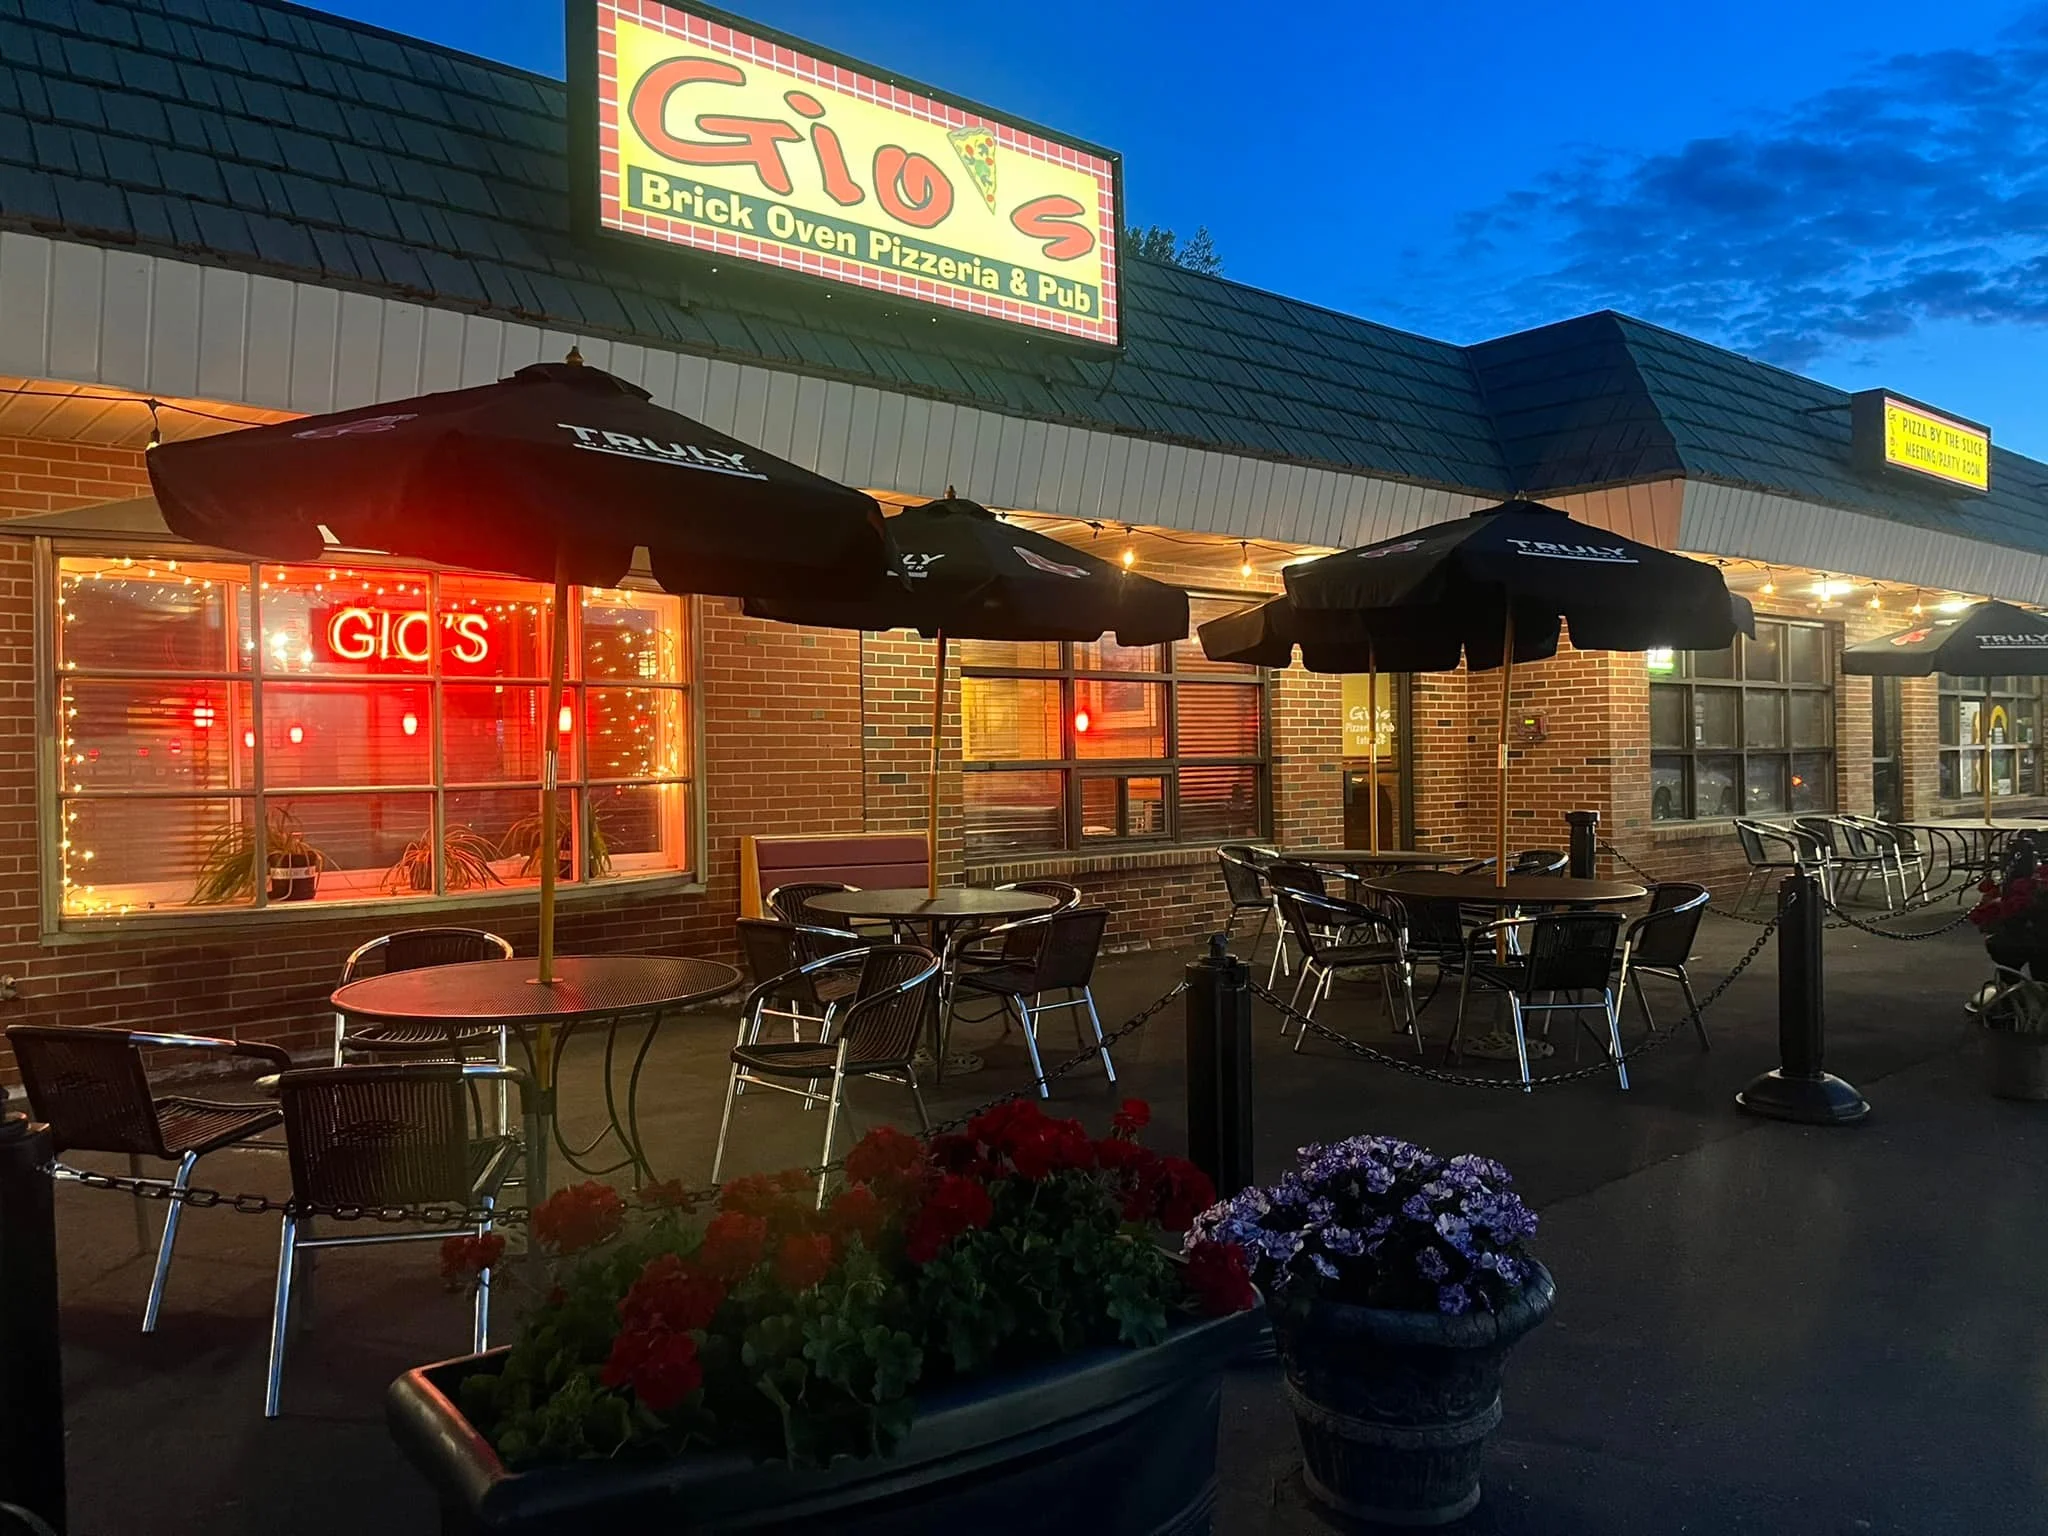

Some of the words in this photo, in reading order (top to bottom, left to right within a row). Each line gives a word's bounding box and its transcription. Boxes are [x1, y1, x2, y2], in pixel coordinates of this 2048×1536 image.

[641, 172, 754, 230] Brick
[766, 204, 857, 255] Oven
[868, 230, 999, 291] Pizzeria
[1009, 267, 1029, 298] &
[1037, 274, 1091, 313] Pub
[556, 422, 745, 467] TRULY
[1902, 417, 1927, 438] PIZZA
[1930, 426, 1942, 443] BY
[1945, 431, 1959, 449] THE
[1962, 438, 1983, 457] SLICE
[1962, 459, 1981, 478] ROOM
[1505, 538, 1625, 556] TRULY
[1975, 634, 2048, 643] TRULY
